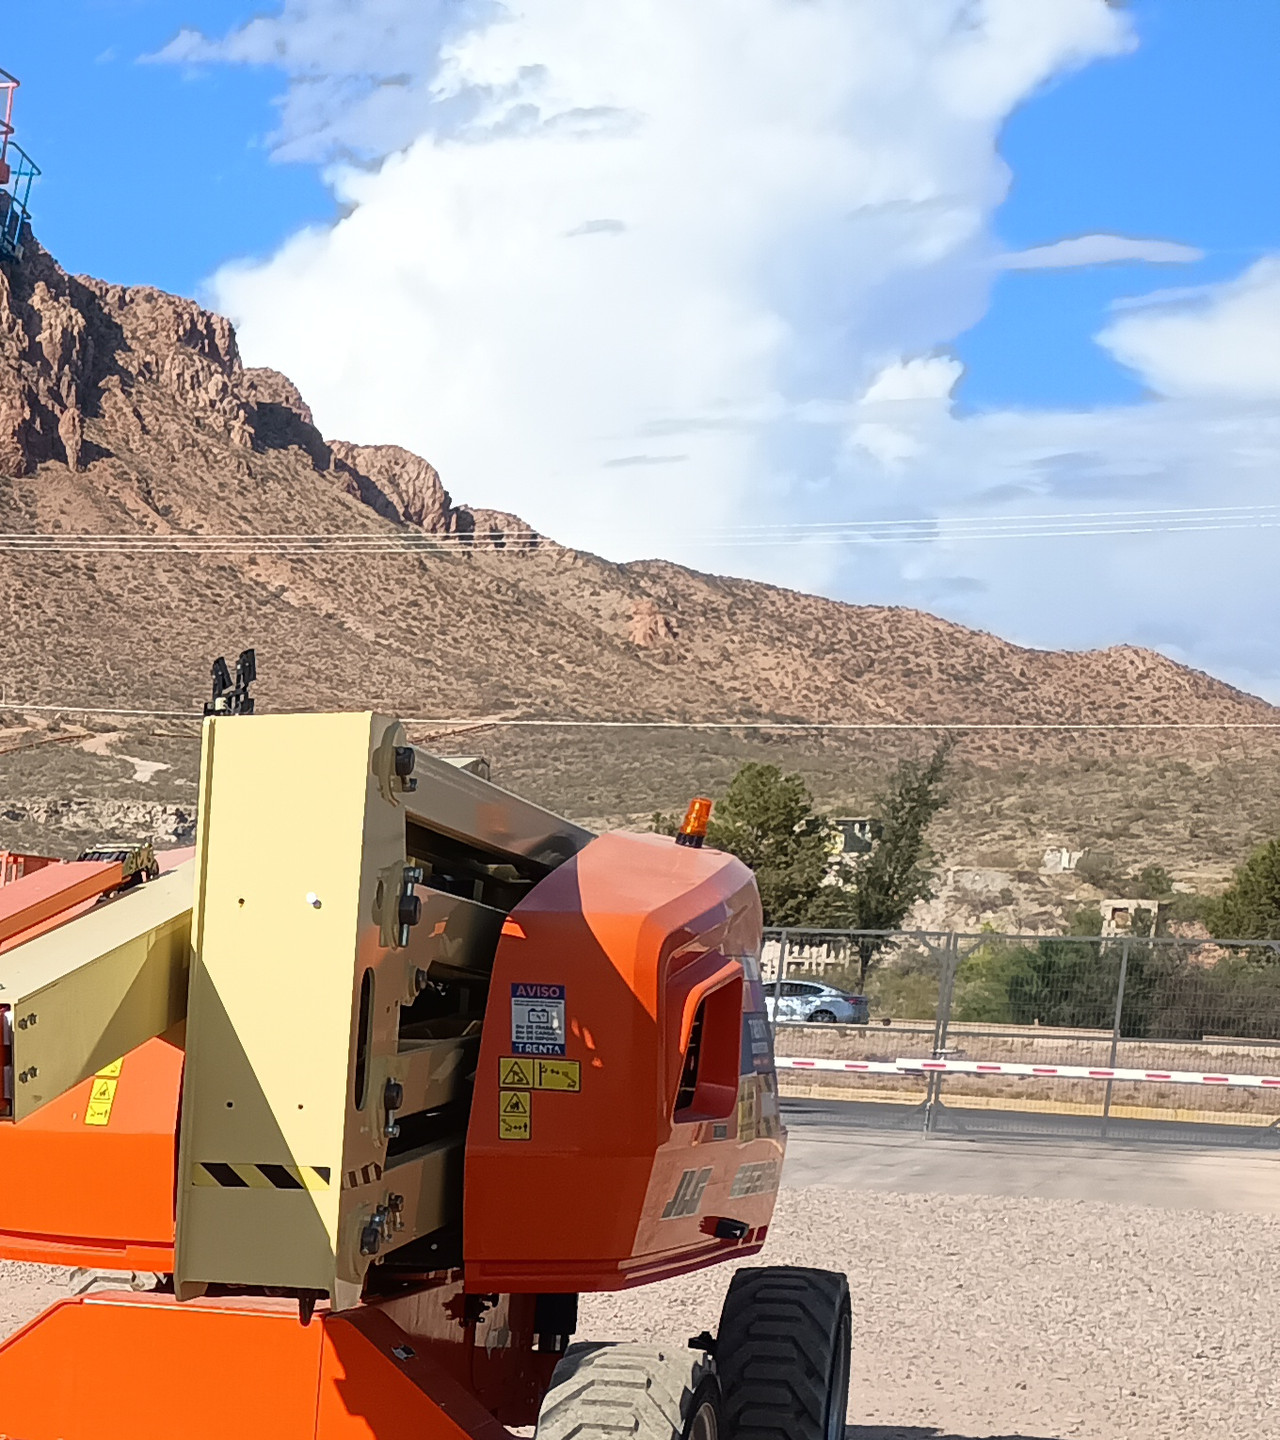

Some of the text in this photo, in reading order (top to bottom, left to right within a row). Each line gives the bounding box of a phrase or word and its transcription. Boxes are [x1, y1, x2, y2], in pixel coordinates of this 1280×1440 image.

[516, 985, 560, 998] AVISO
[516, 1043, 561, 1054] TRENTA
[659, 1166, 714, 1220] JLG
